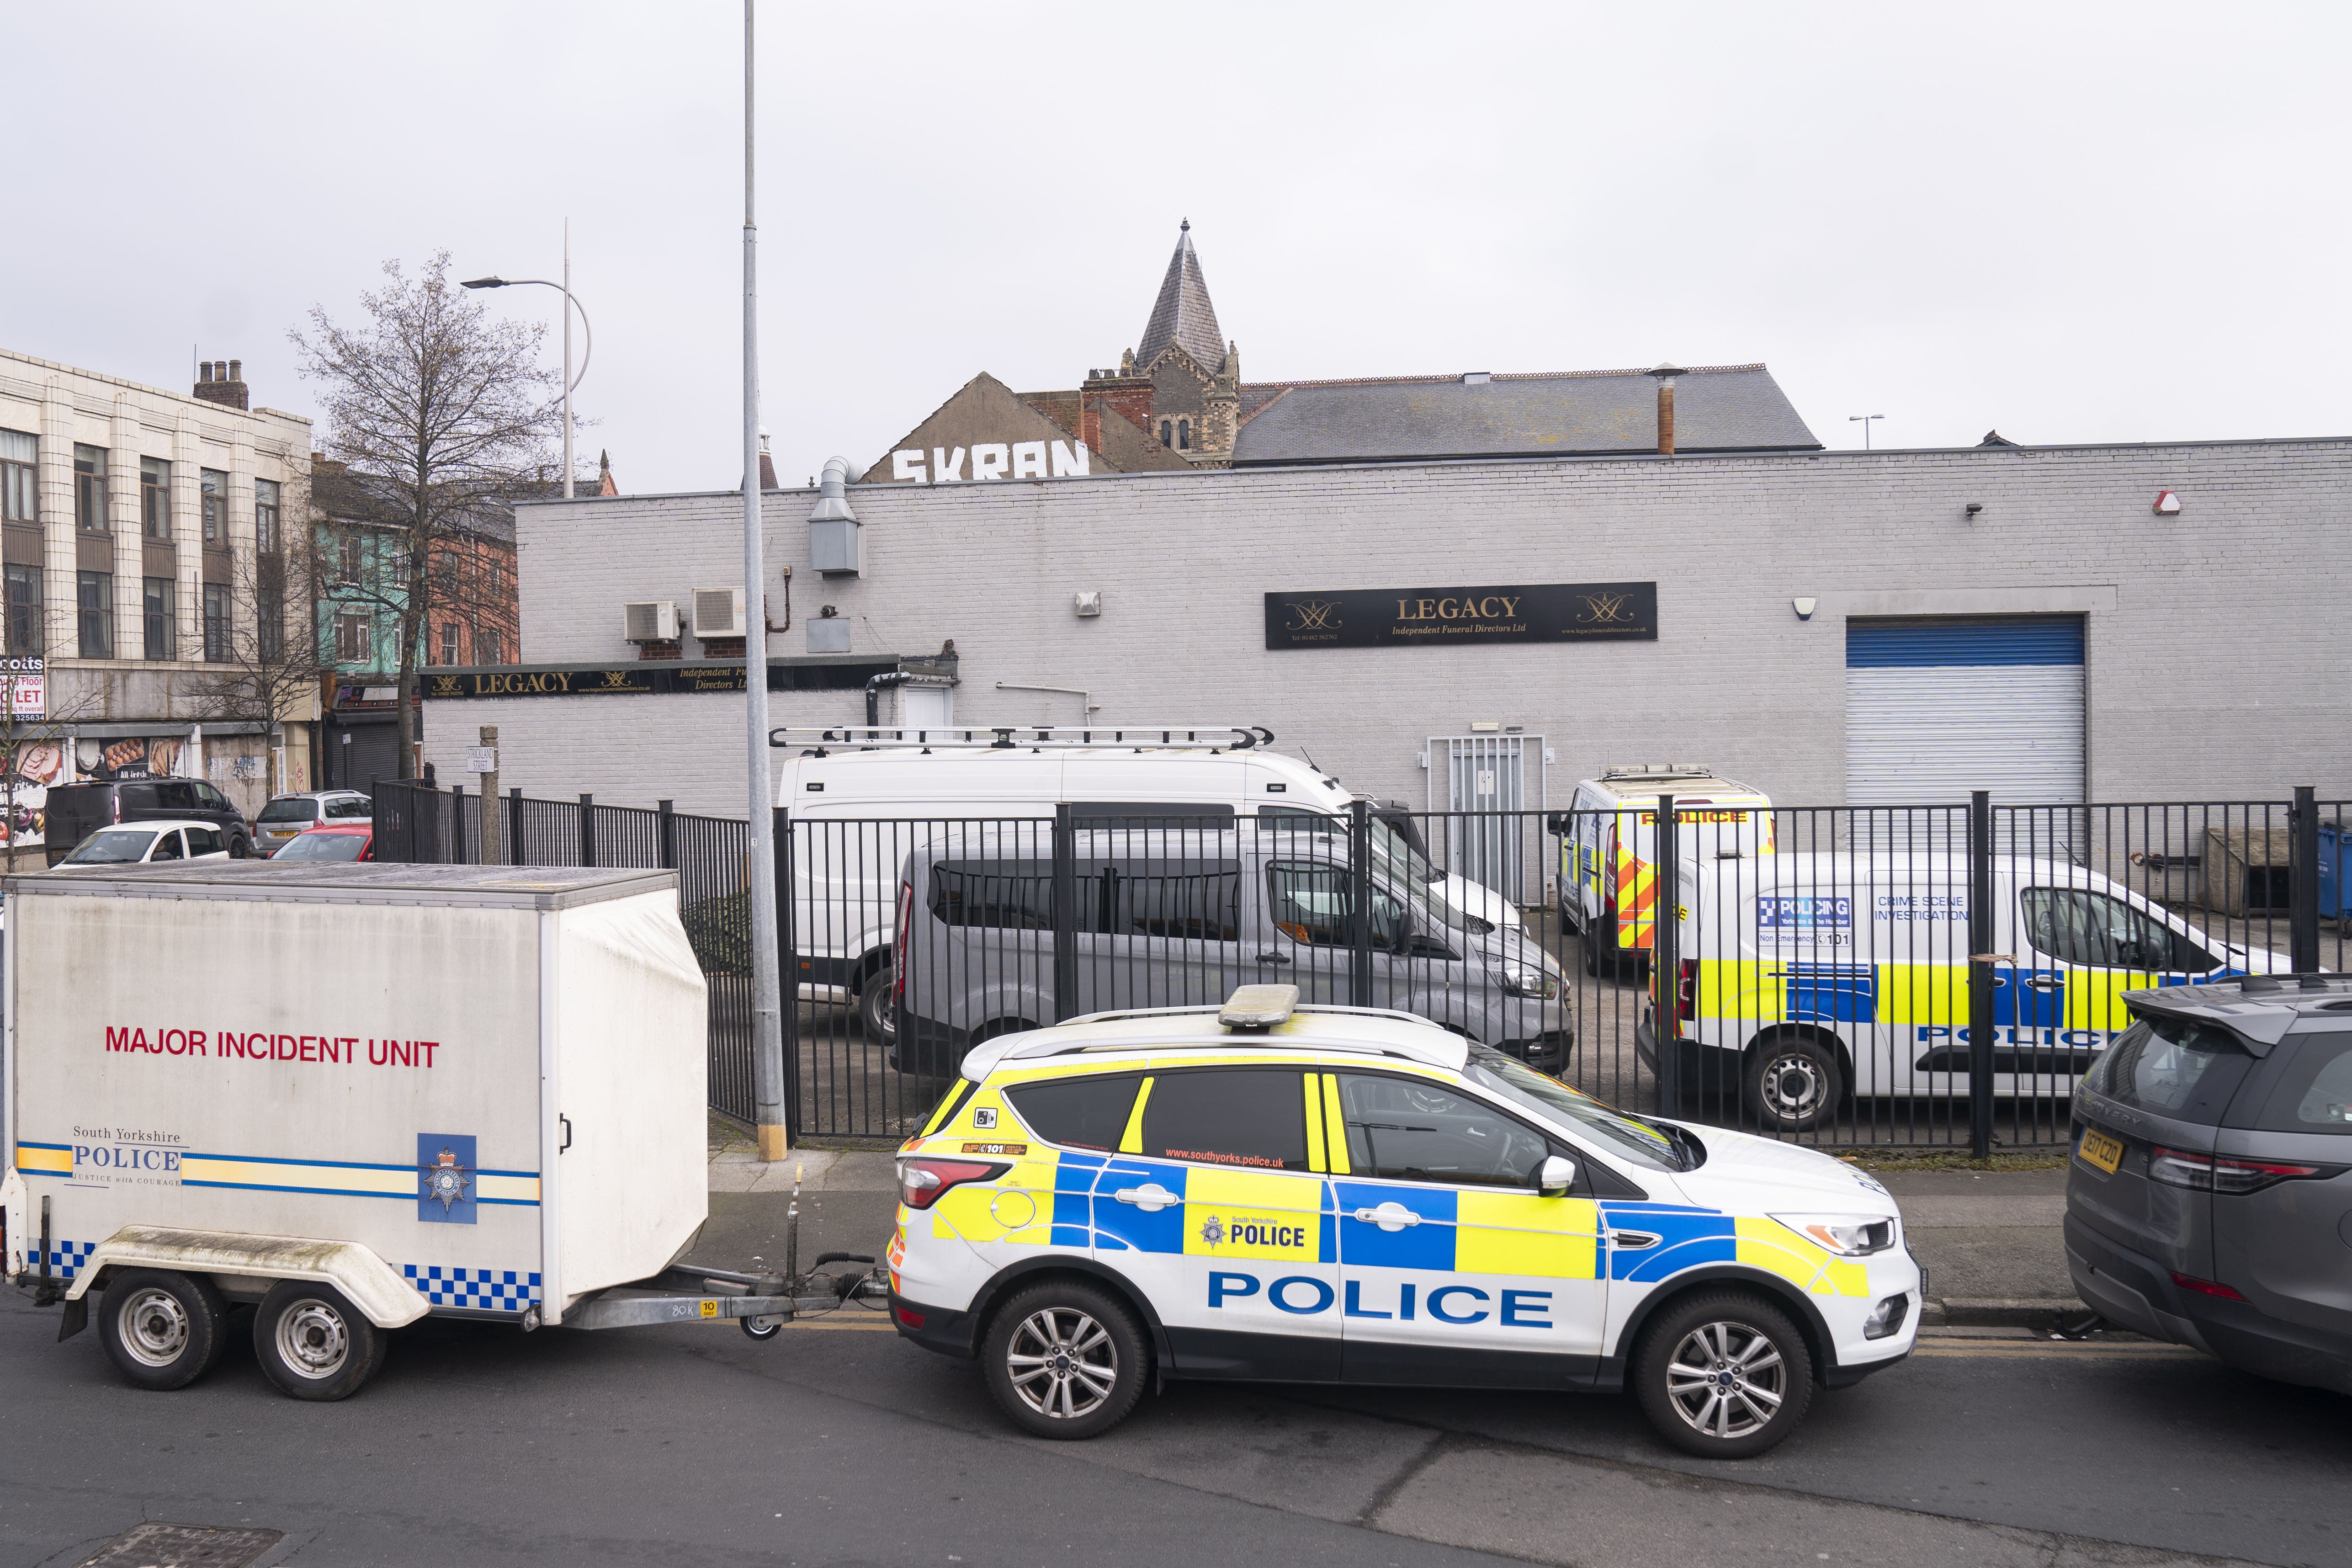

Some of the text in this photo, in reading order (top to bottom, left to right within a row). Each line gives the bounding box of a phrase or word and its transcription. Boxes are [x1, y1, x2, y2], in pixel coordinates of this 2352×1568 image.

[892, 440, 1090, 483] SKRAN
[1396, 596, 1521, 620] LEGACY
[1392, 623, 1526, 636] Independent Funeral Directors Ltd
[680, 668, 731, 678] Independent
[22, 677, 42, 686] Floor
[475, 673, 573, 693] LEGACY
[695, 679, 747, 690] Directors Lt
[16, 690, 41, 703] LET
[468, 749, 493, 759] STRICKLAND
[473, 760, 488, 771] STREET
[1780, 900, 1848, 915] POLICING
[1879, 897, 1963, 906] CRIME SCENE
[1875, 911, 1969, 920] INVESTIGATION
[1827, 934, 1848, 945] 101
[106, 1026, 440, 1068] MAJOR INCIDENT UNIT
[73, 1126, 181, 1143] South Yorkshire
[987, 1144, 1003, 1153] 101
[2083, 1132, 2102, 1155] OE17
[74, 1145, 180, 1171] POLICE
[1166, 1148, 1284, 1168] www.southyorks.police.uk
[73, 1173, 111, 1182] JUSTICE
[137, 1177, 181, 1187] COURAGE
[1232, 1224, 1304, 1247] POLICE
[703, 1302, 714, 1310] 10
[1208, 1270, 1553, 1329] POLICE
